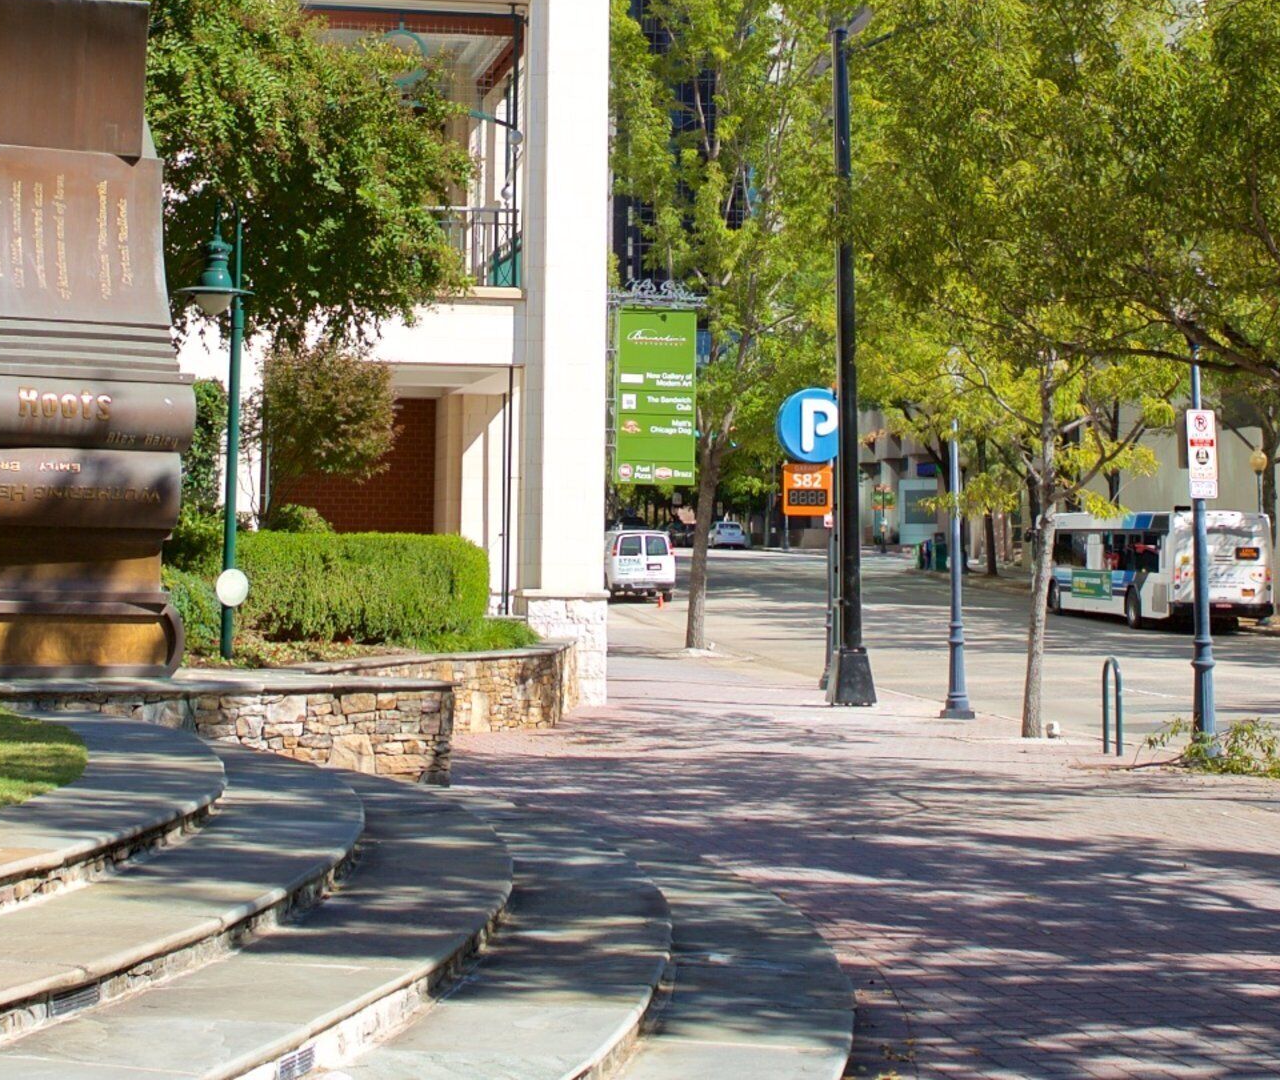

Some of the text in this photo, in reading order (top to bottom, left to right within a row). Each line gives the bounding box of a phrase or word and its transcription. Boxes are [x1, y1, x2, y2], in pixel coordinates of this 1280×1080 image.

[53, 202, 67, 214] of
[54, 216, 66, 238] and
[59, 288, 72, 300] of
[18, 386, 112, 421] Roots
[650, 426, 692, 435] Chicago Dog
[802, 399, 838, 452] P
[106, 432, 179, 448] Alex Haley
[39, 461, 80, 472] EMILY
[792, 474, 822, 488] S82
[33, 485, 160, 503] WUTHERING
